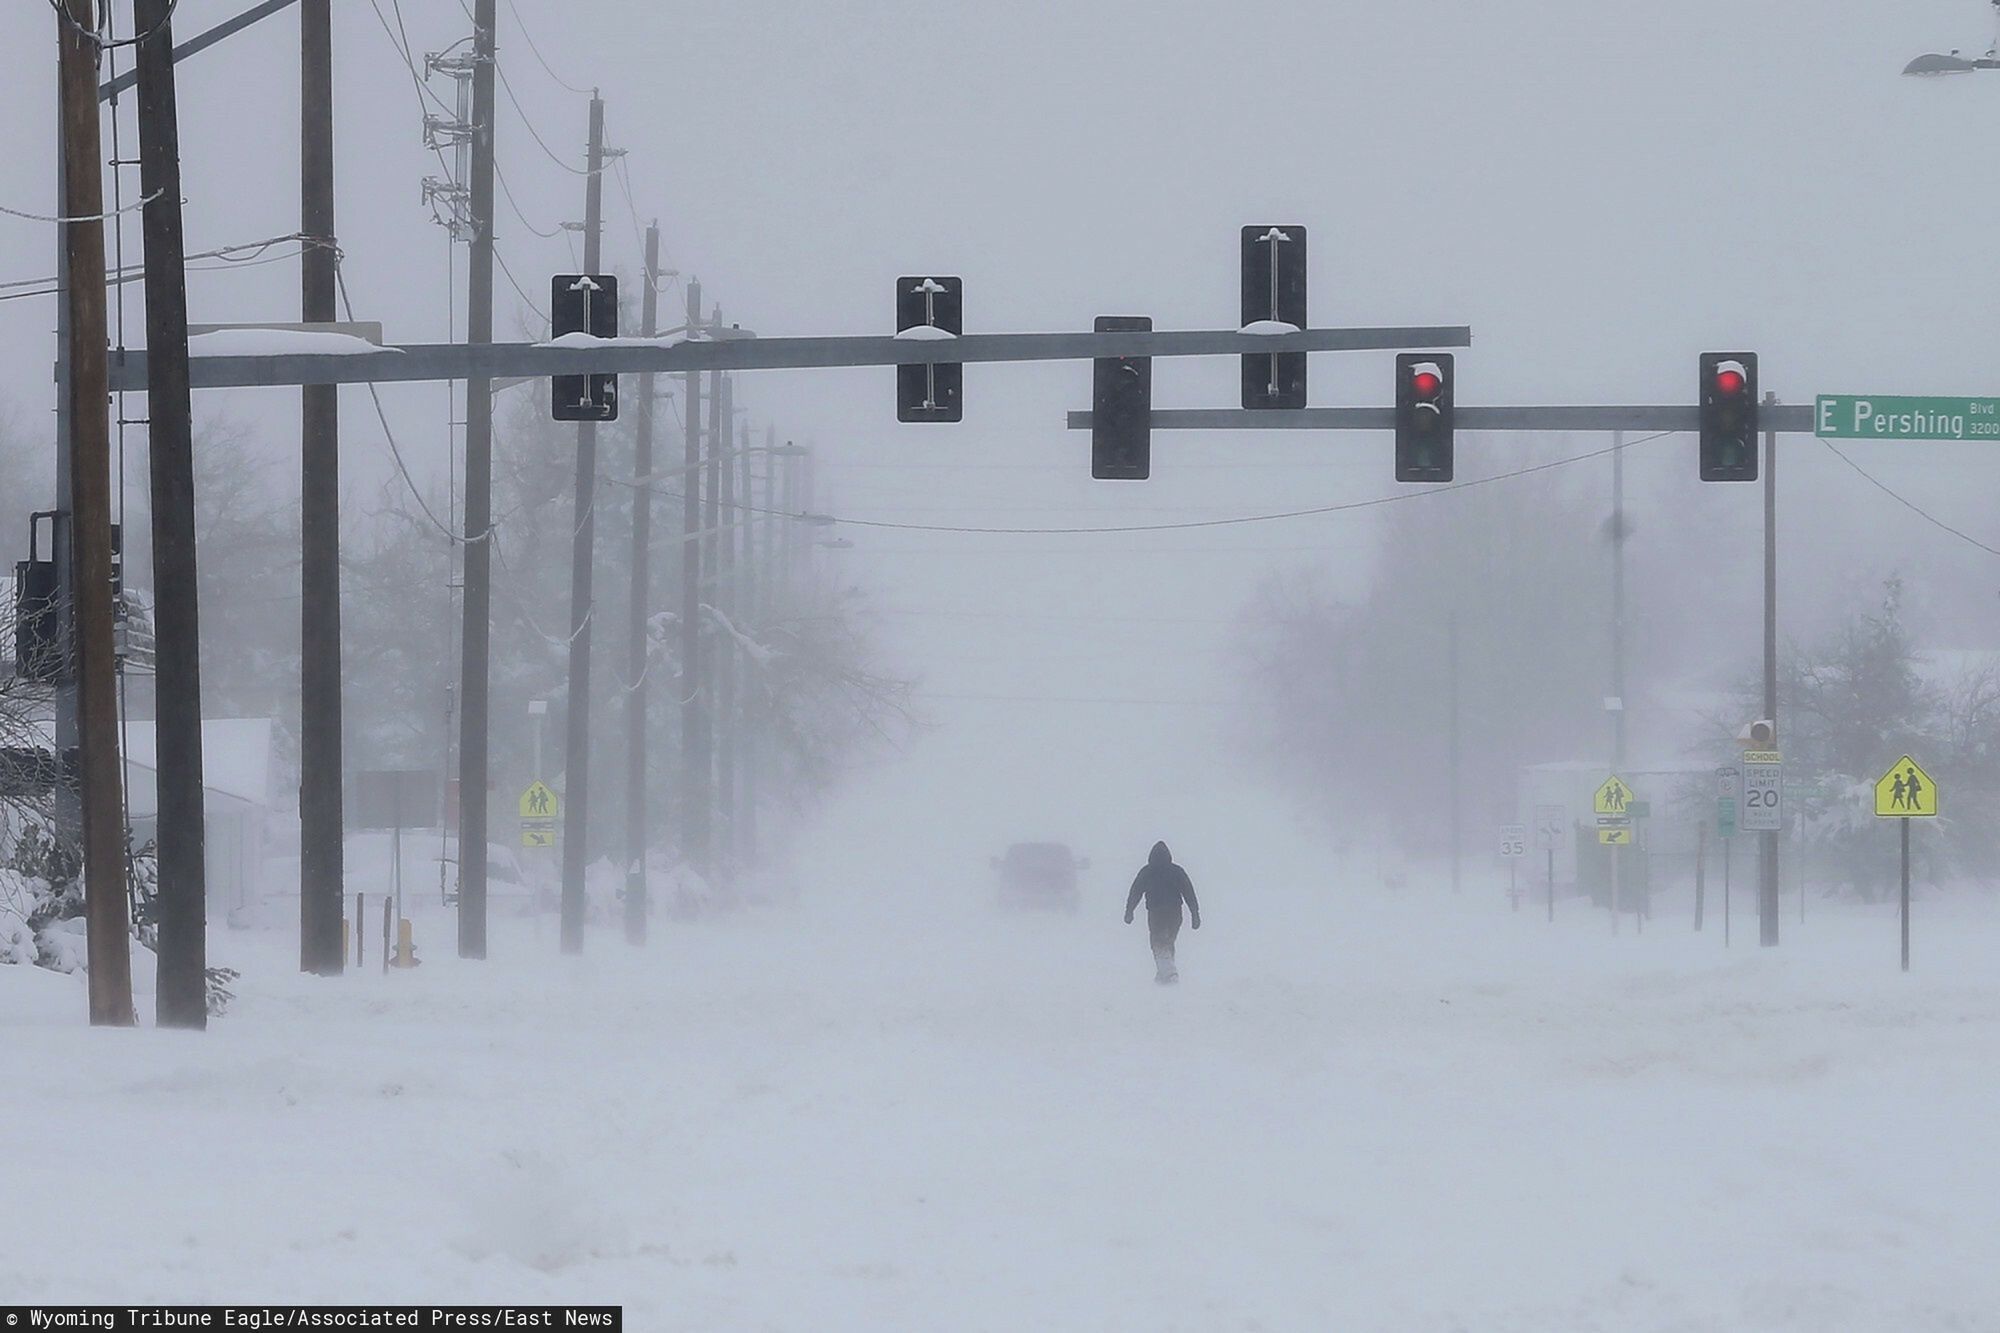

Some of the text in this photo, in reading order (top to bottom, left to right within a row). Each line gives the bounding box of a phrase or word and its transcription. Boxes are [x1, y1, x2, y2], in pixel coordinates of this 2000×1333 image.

[1970, 402, 1995, 414] Blvd
[1820, 400, 1964, 439] E Pershing
[1970, 423, 2000, 435] 3200
[1745, 752, 1781, 762] SCHOOL
[1746, 768, 1780, 778] SPEED
[1749, 779, 1775, 788] LIMIT
[1747, 789, 1779, 808] 20
[1502, 841, 1524, 856] 35
